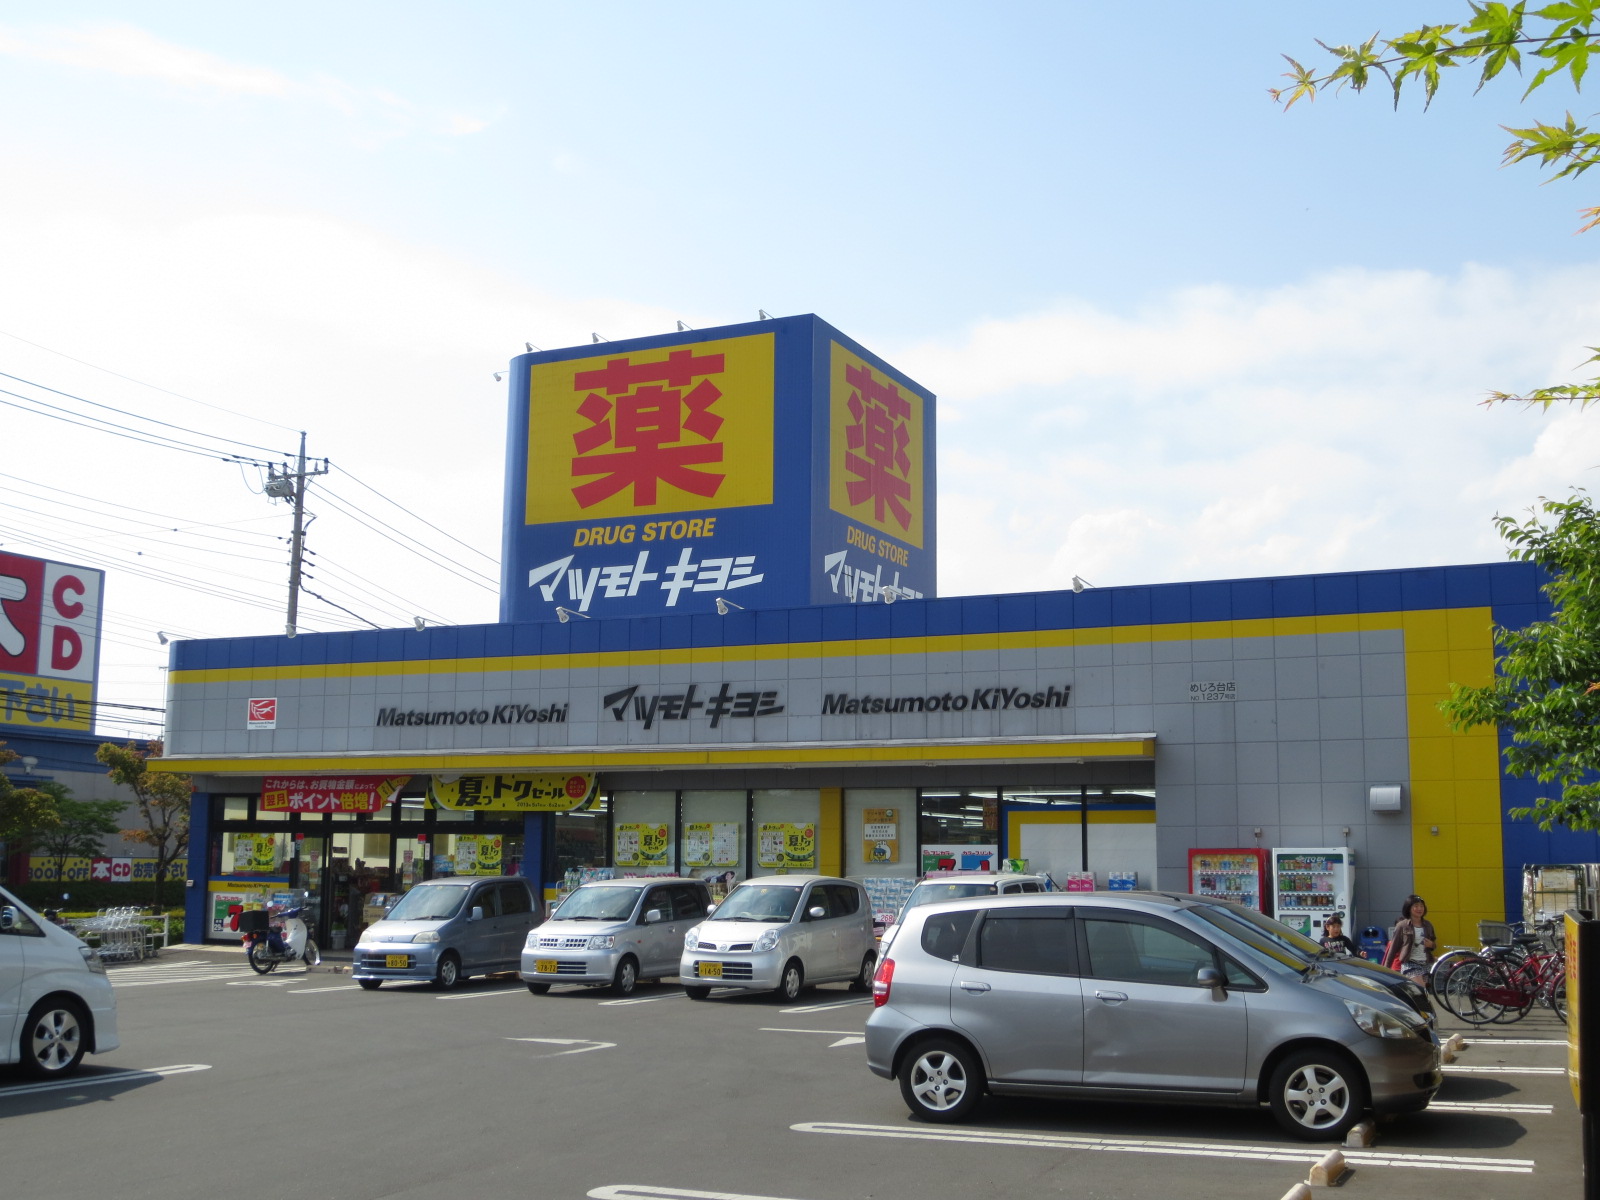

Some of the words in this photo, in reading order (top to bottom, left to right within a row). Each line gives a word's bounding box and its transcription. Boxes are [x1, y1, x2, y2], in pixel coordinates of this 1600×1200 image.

[570, 349, 726, 509] 薬
[845, 363, 911, 532] 薬
[573, 524, 636, 547] DRUG
[643, 517, 717, 541] STORE
[846, 525, 876, 553] DRUG
[878, 539, 909, 567] STORE
[52, 574, 86, 671] CD
[1190, 682, 1235, 692] めじろ台店
[92, 861, 110, 879] 本
[112, 863, 131, 877] CD
[880, 914, 893, 922] 268
[704, 968, 721, 976] 14-50
